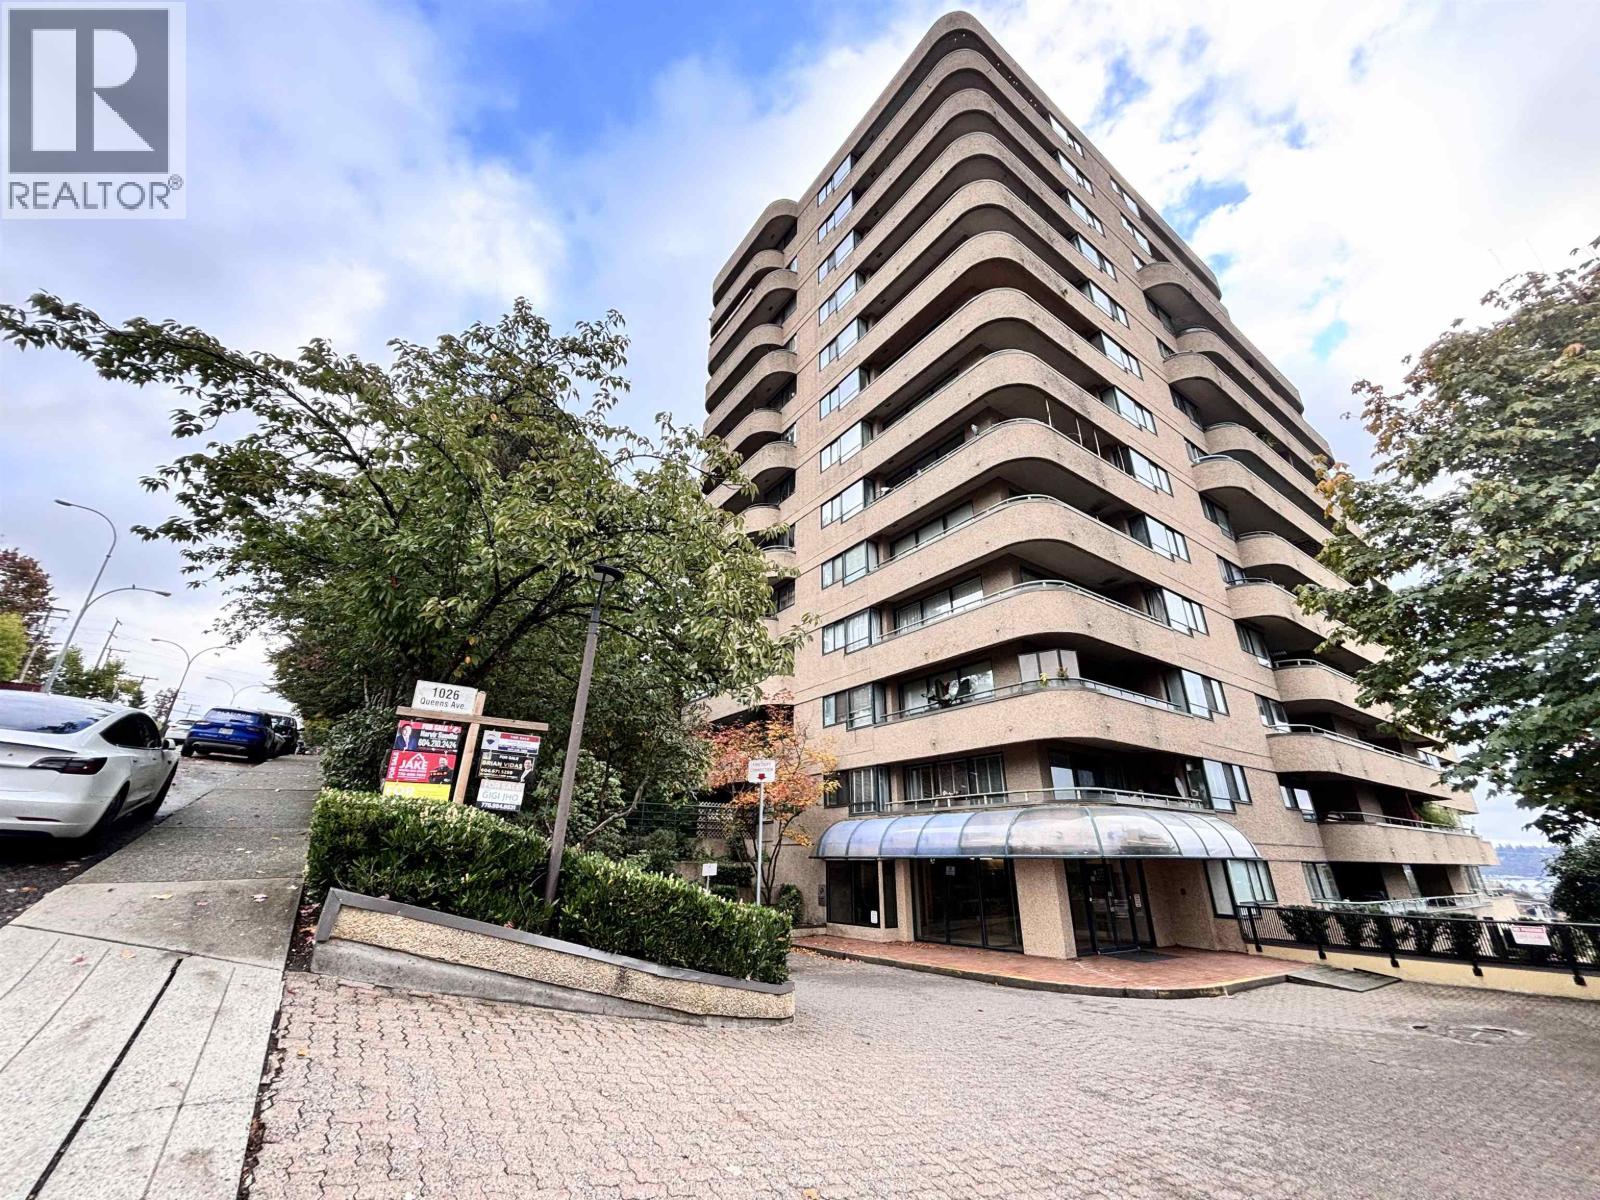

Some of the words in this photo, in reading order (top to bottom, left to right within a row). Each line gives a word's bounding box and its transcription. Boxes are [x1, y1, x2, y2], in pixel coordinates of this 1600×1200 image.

[432, 687, 460, 701] 1026
[420, 697, 448, 708] Queens
[450, 701, 465, 710] Ave
[398, 759, 429, 770] JAKE
[482, 760, 502, 768] BRIAN
[482, 791, 500, 800] GIGI
